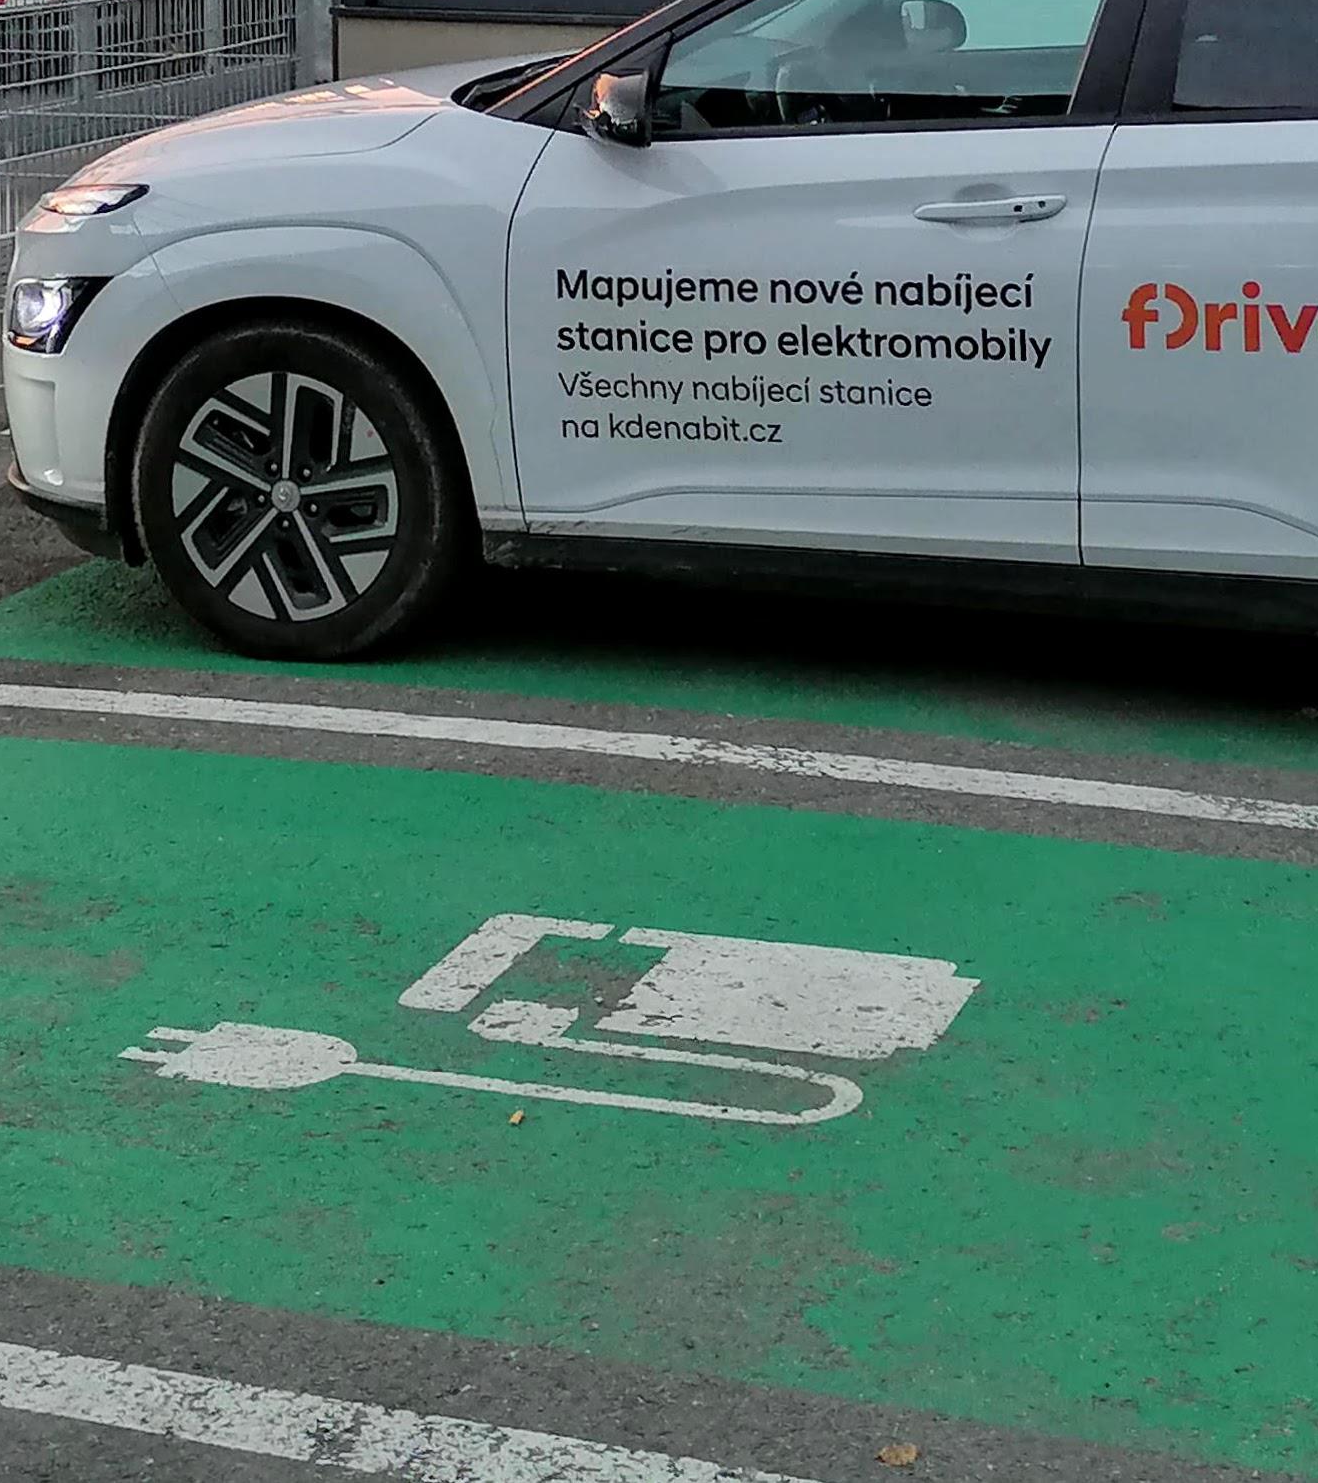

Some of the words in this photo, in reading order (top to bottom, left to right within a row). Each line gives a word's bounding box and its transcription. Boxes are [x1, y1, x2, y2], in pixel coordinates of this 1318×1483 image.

[556, 268, 759, 309] Mapujeme
[770, 270, 864, 305] nové
[875, 272, 1034, 315] nabíjecí
[556, 320, 694, 354] stanice
[704, 329, 767, 361] pro
[777, 323, 1053, 369] elektromobily
[558, 371, 684, 405] Všechny
[692, 374, 811, 408] nabíjecí
[819, 378, 933, 407] stanice
[561, 419, 599, 439] na
[608, 413, 783, 443] kdenabit.cz
